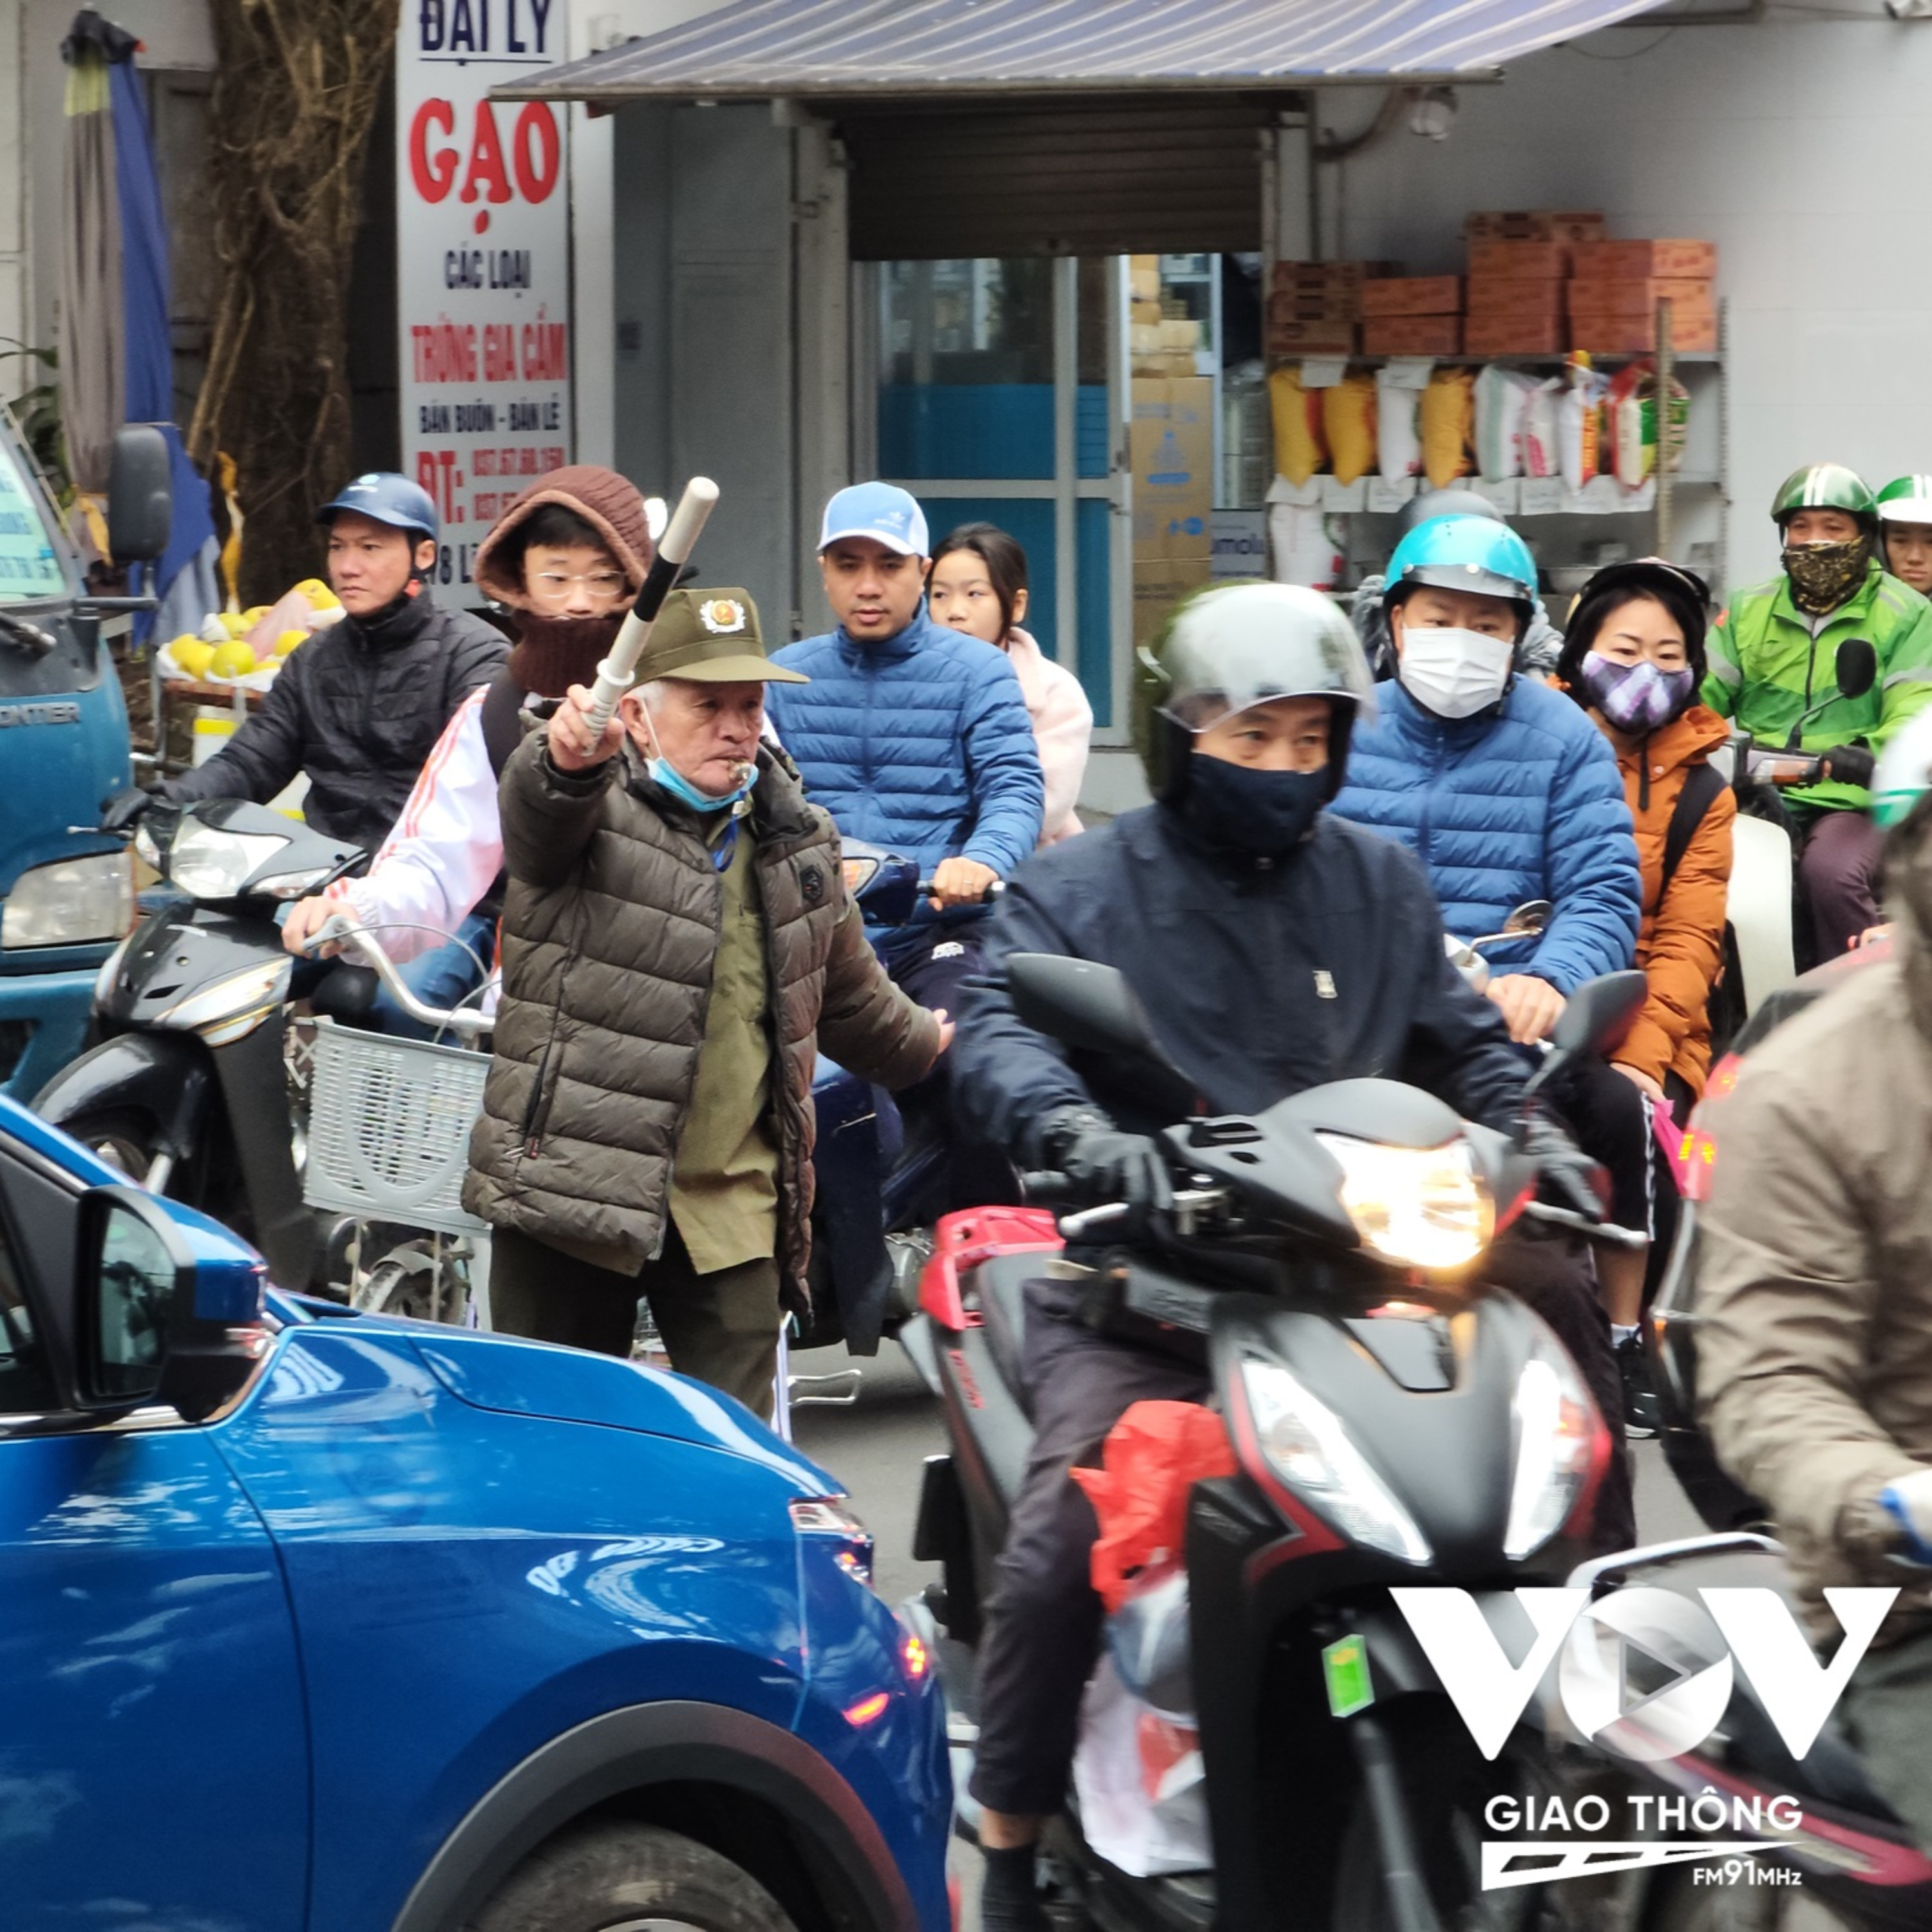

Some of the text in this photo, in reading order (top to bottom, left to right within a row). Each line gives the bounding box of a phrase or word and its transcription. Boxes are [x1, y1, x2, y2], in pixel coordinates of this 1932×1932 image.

[408, 97, 559, 234] GẠO
[444, 240, 531, 298] CÁC LOẠI
[484, 323, 516, 382] GIA
